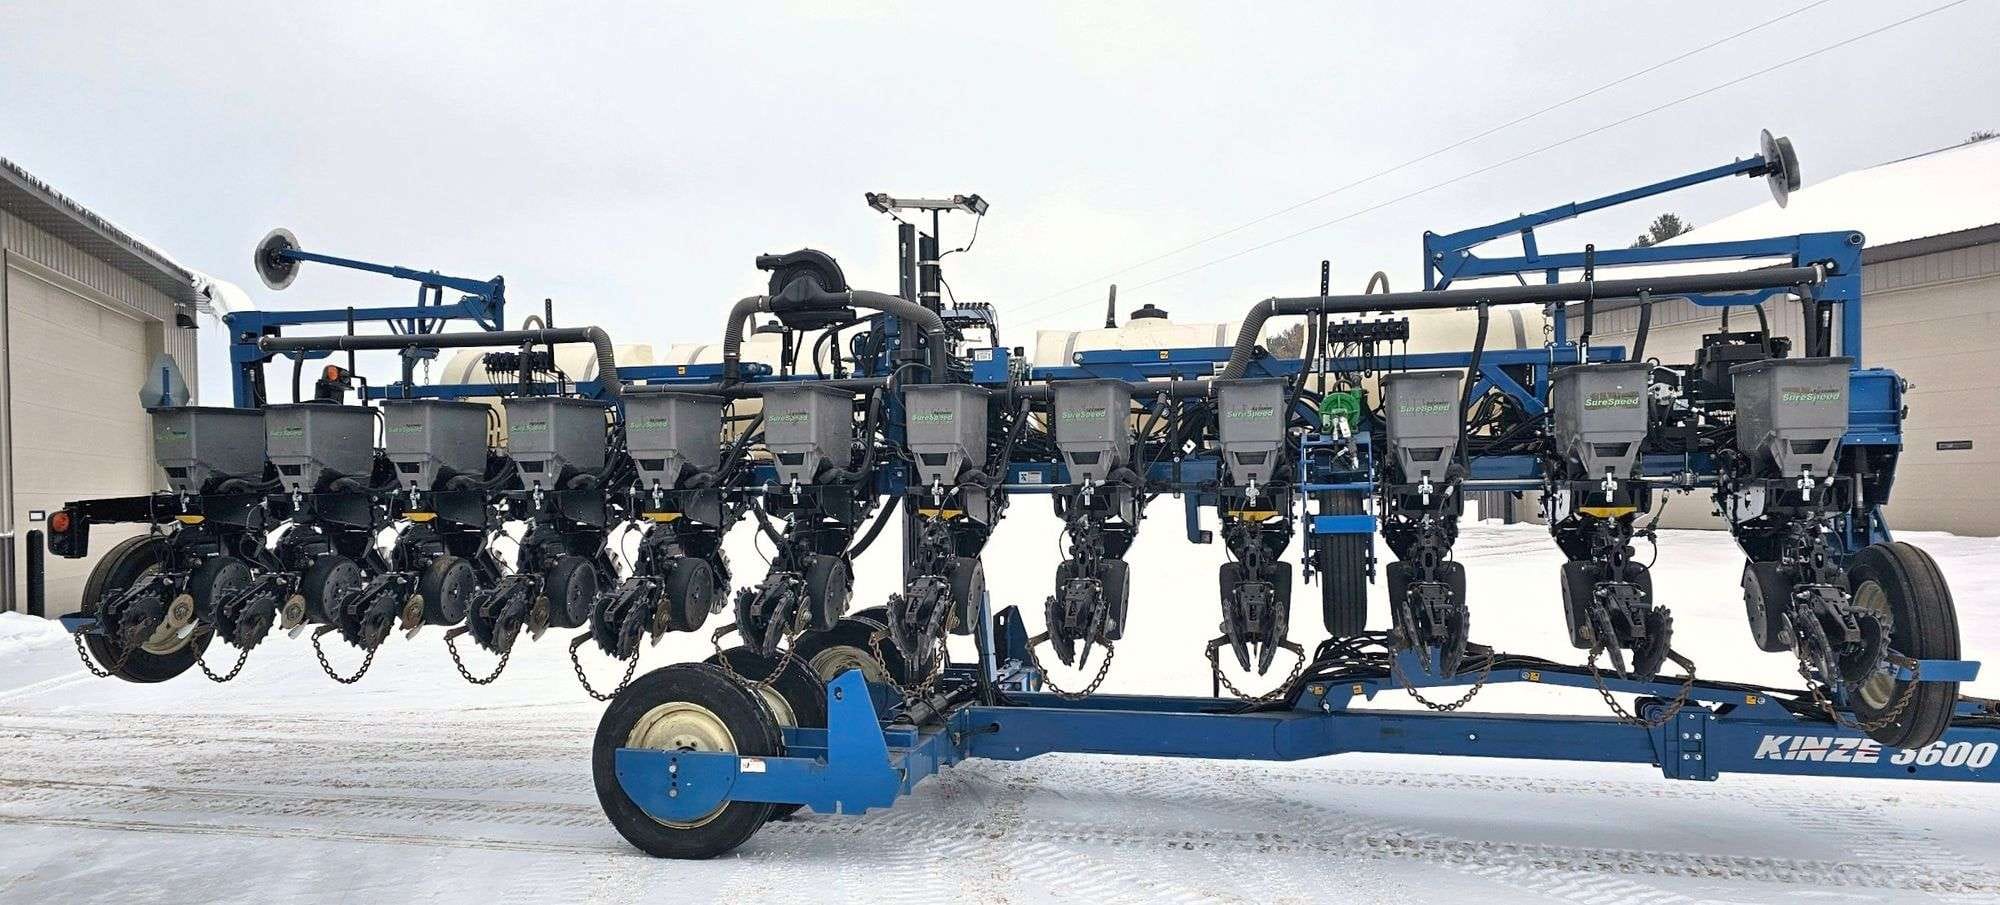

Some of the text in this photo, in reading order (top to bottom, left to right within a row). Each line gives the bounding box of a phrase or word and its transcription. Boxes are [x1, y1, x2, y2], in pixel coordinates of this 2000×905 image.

[1585, 397, 1638, 408] SureSpeed
[1227, 408, 1273, 418] SureSpeed
[1754, 735, 1882, 764] KINZE
